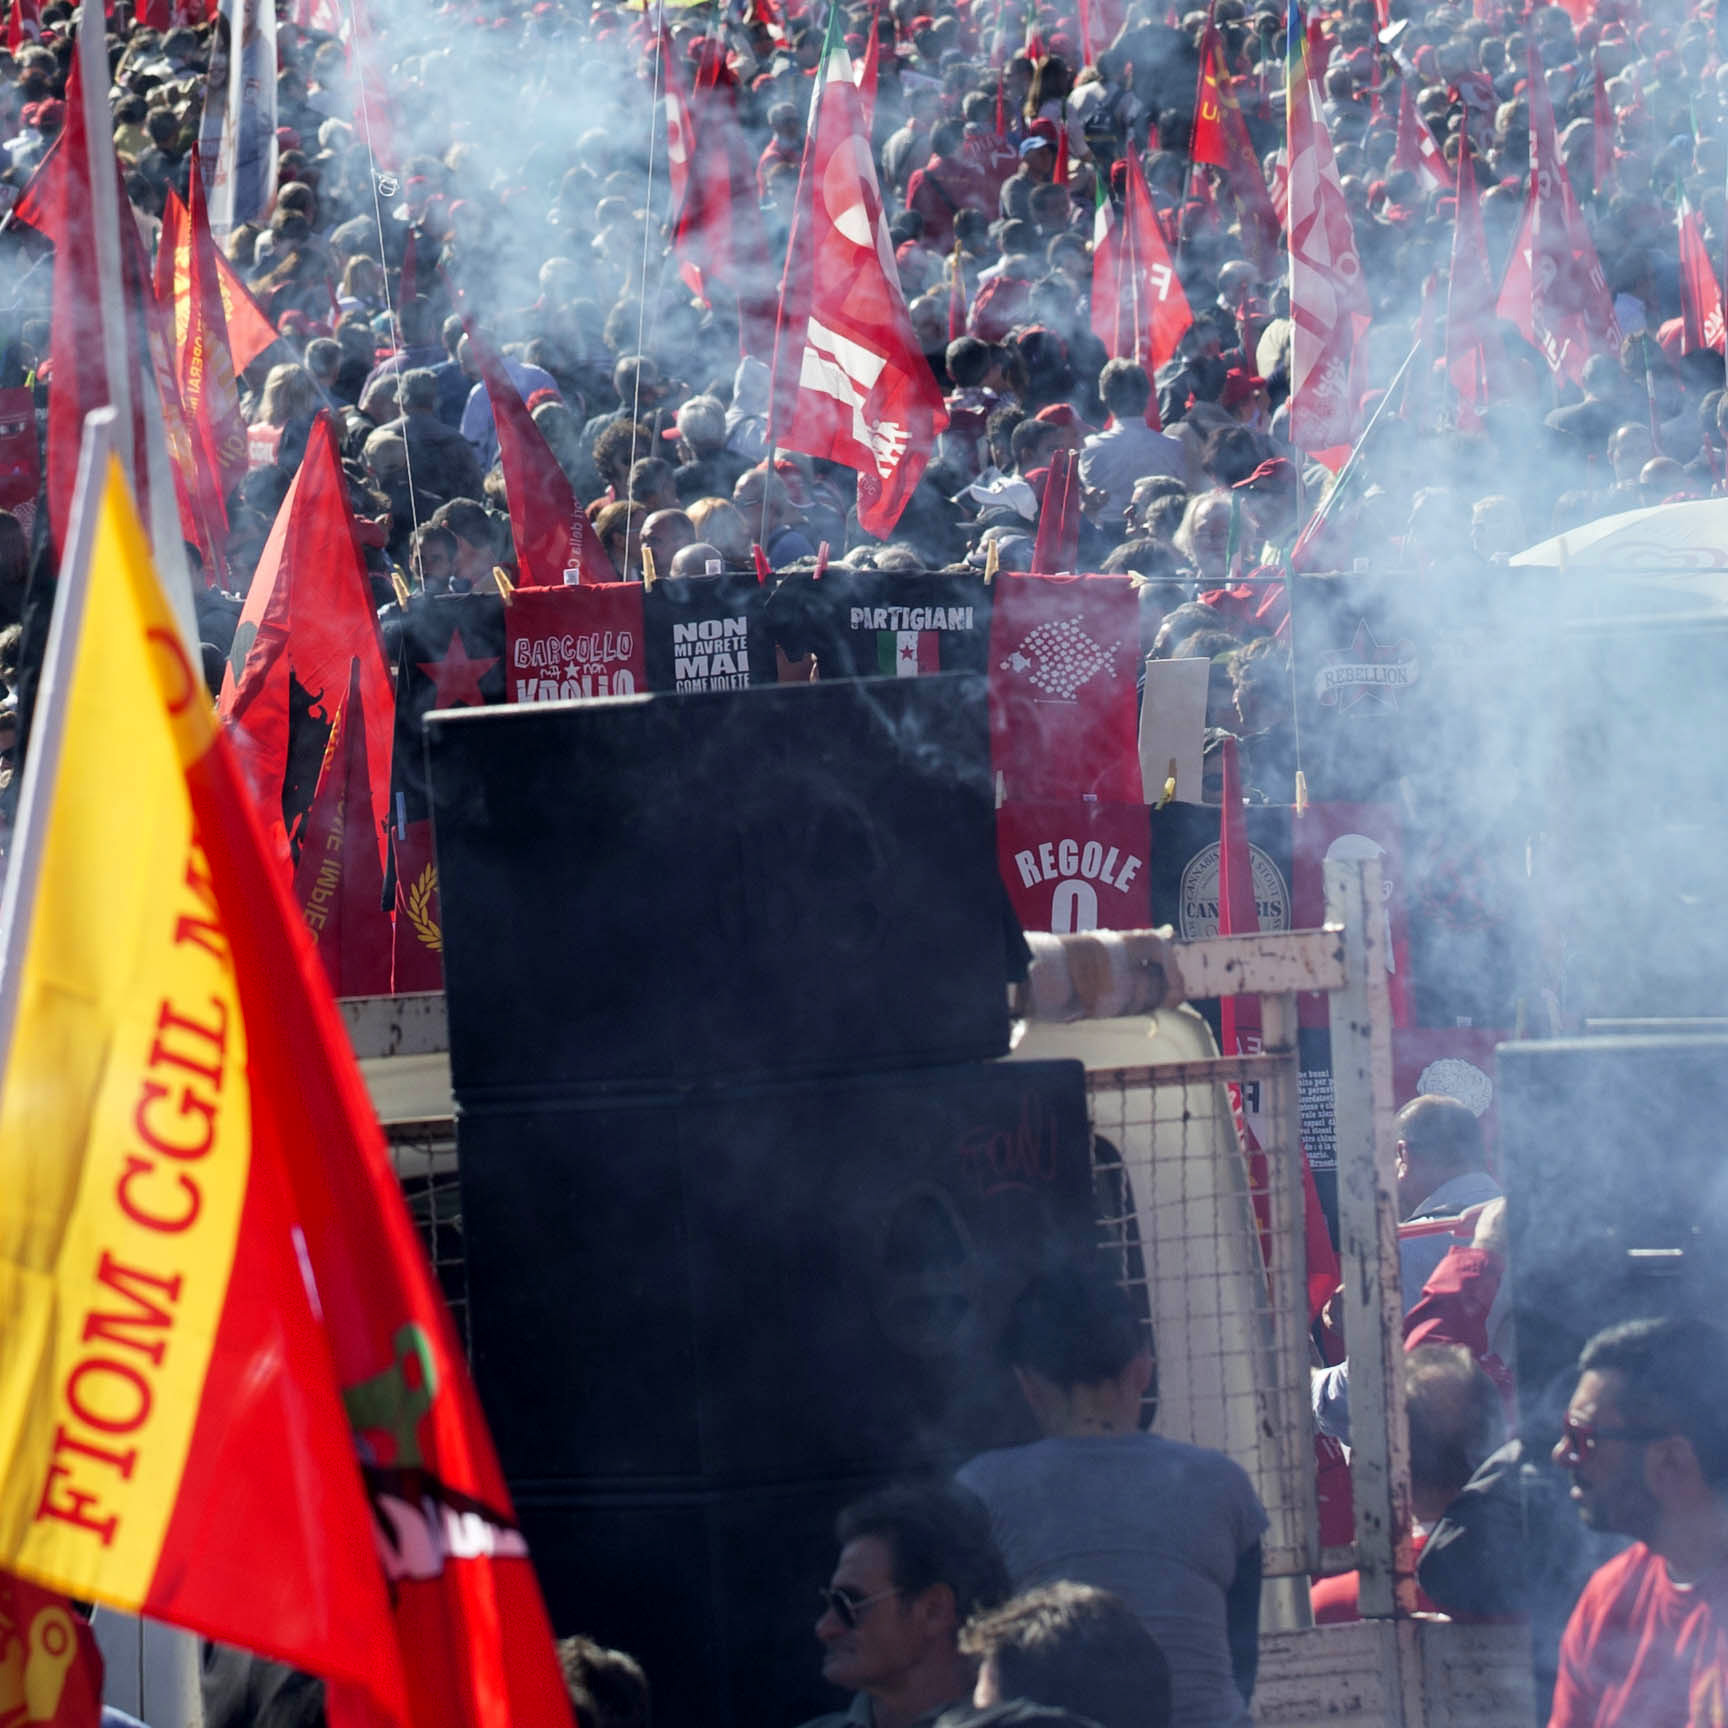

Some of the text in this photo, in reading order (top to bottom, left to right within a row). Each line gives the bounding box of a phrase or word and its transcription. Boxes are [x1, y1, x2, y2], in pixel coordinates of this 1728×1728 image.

[673, 616, 748, 643] NON
[850, 605, 974, 631] PARTIGIANI
[513, 631, 634, 668] BARCOLLO
[674, 636, 748, 657] MI AVRETE
[675, 652, 750, 679] MAI
[1324, 663, 1410, 689] REBELLION
[1014, 838, 1143, 894] REGOLE
[1186, 899, 1282, 919] CANBIS
[33, 1245, 184, 1552] FIOM
[114, 998, 232, 1238] CGIL
